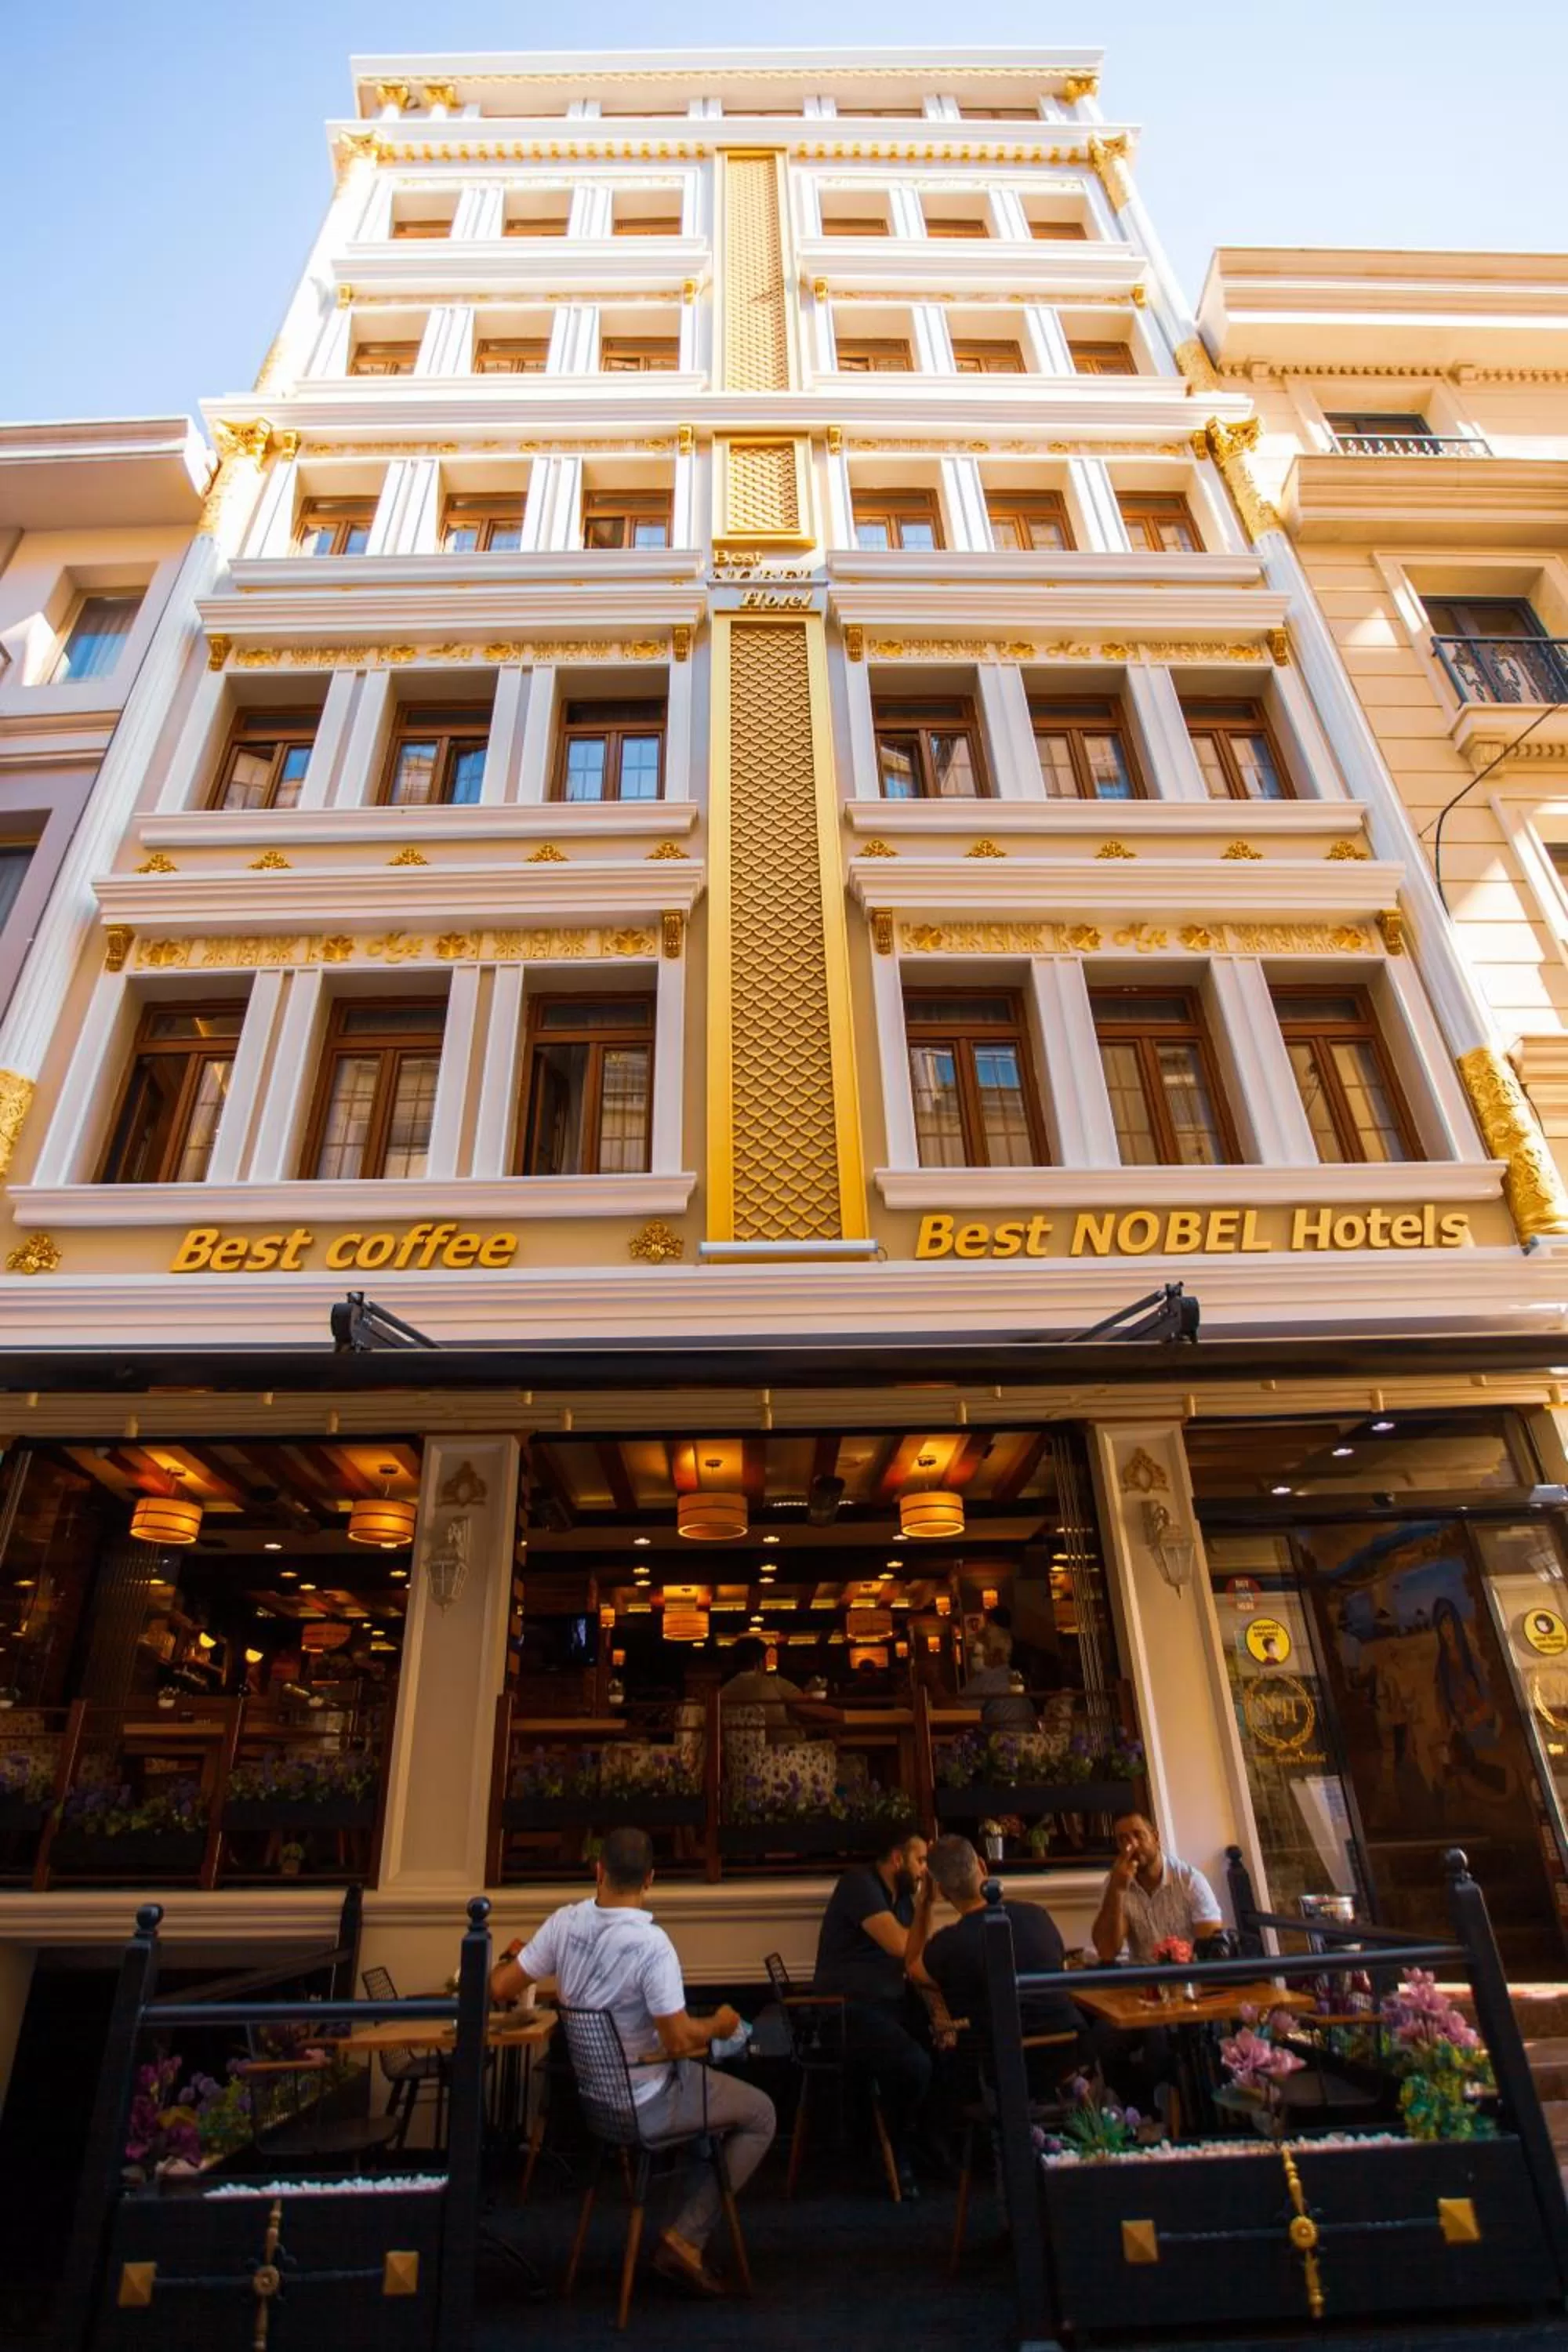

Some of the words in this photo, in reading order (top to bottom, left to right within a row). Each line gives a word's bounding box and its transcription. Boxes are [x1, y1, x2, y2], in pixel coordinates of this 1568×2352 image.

[713, 550, 764, 566] Best
[740, 589, 814, 608] Hotel
[169, 1228, 314, 1272] Best
[325, 1222, 519, 1269] coffee
[915, 1214, 1054, 1258] Best
[1070, 1210, 1272, 1256] NOBEL
[1291, 1203, 1470, 1250] Hotels
